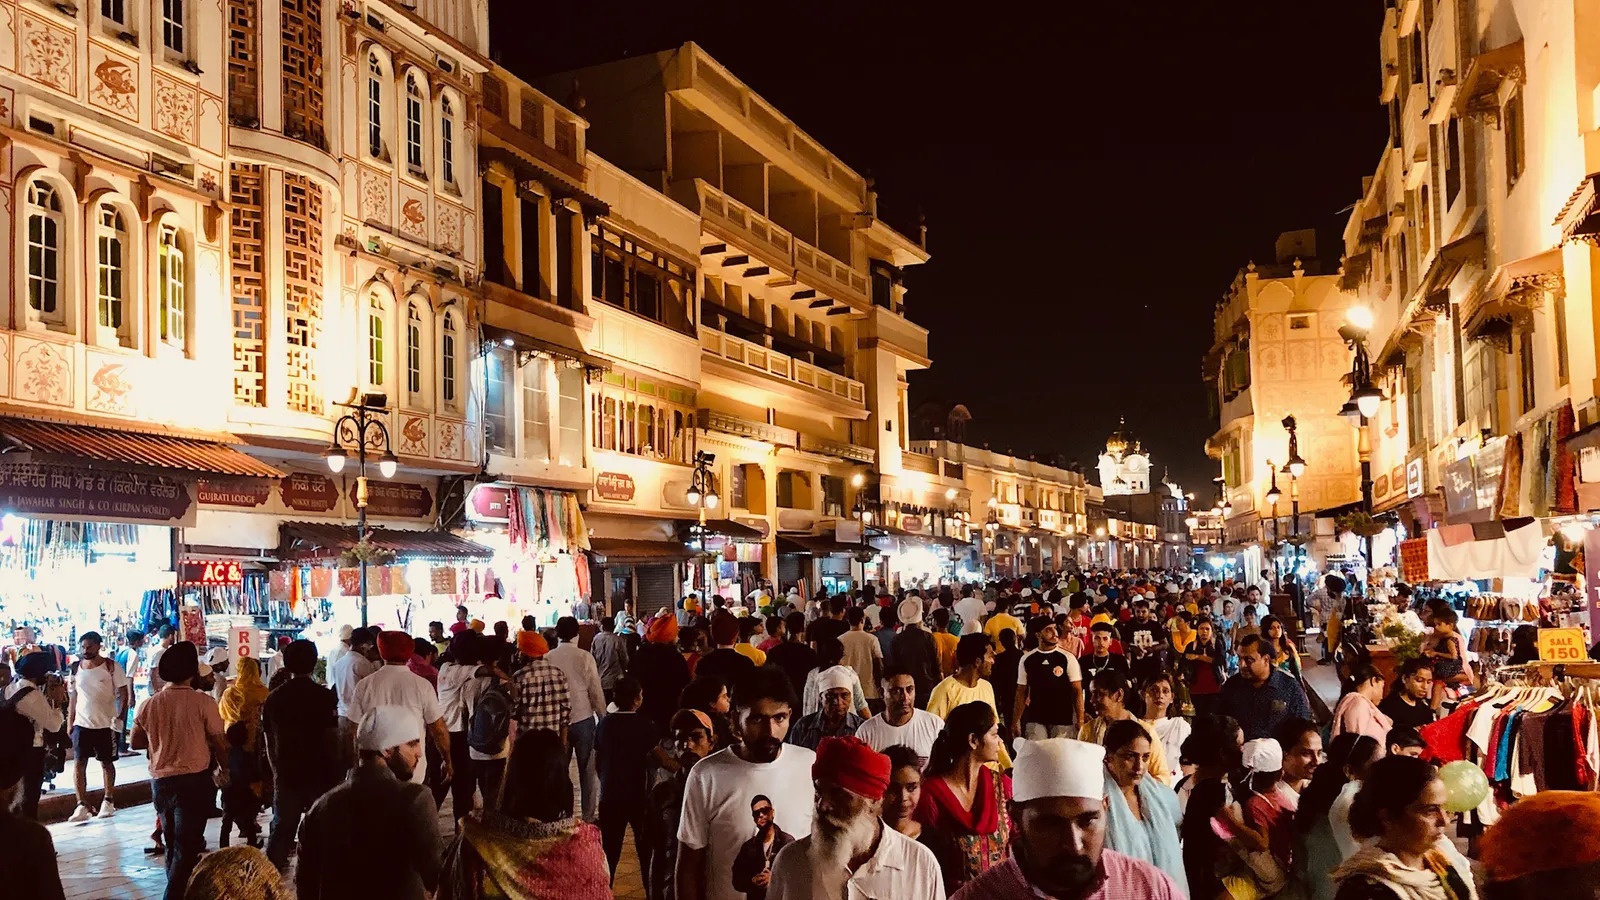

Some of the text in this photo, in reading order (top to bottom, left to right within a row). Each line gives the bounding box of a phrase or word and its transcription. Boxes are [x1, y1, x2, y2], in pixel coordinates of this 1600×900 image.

[17, 496, 55, 509] JAWAHAR
[59, 499, 85, 509] SINGH
[88, 502, 94, 511] &
[199, 491, 256, 504] GUJRATI LODGE
[203, 565, 241, 581] AC &
[1550, 638, 1573, 646] SALE
[1547, 647, 1580, 659] 150
